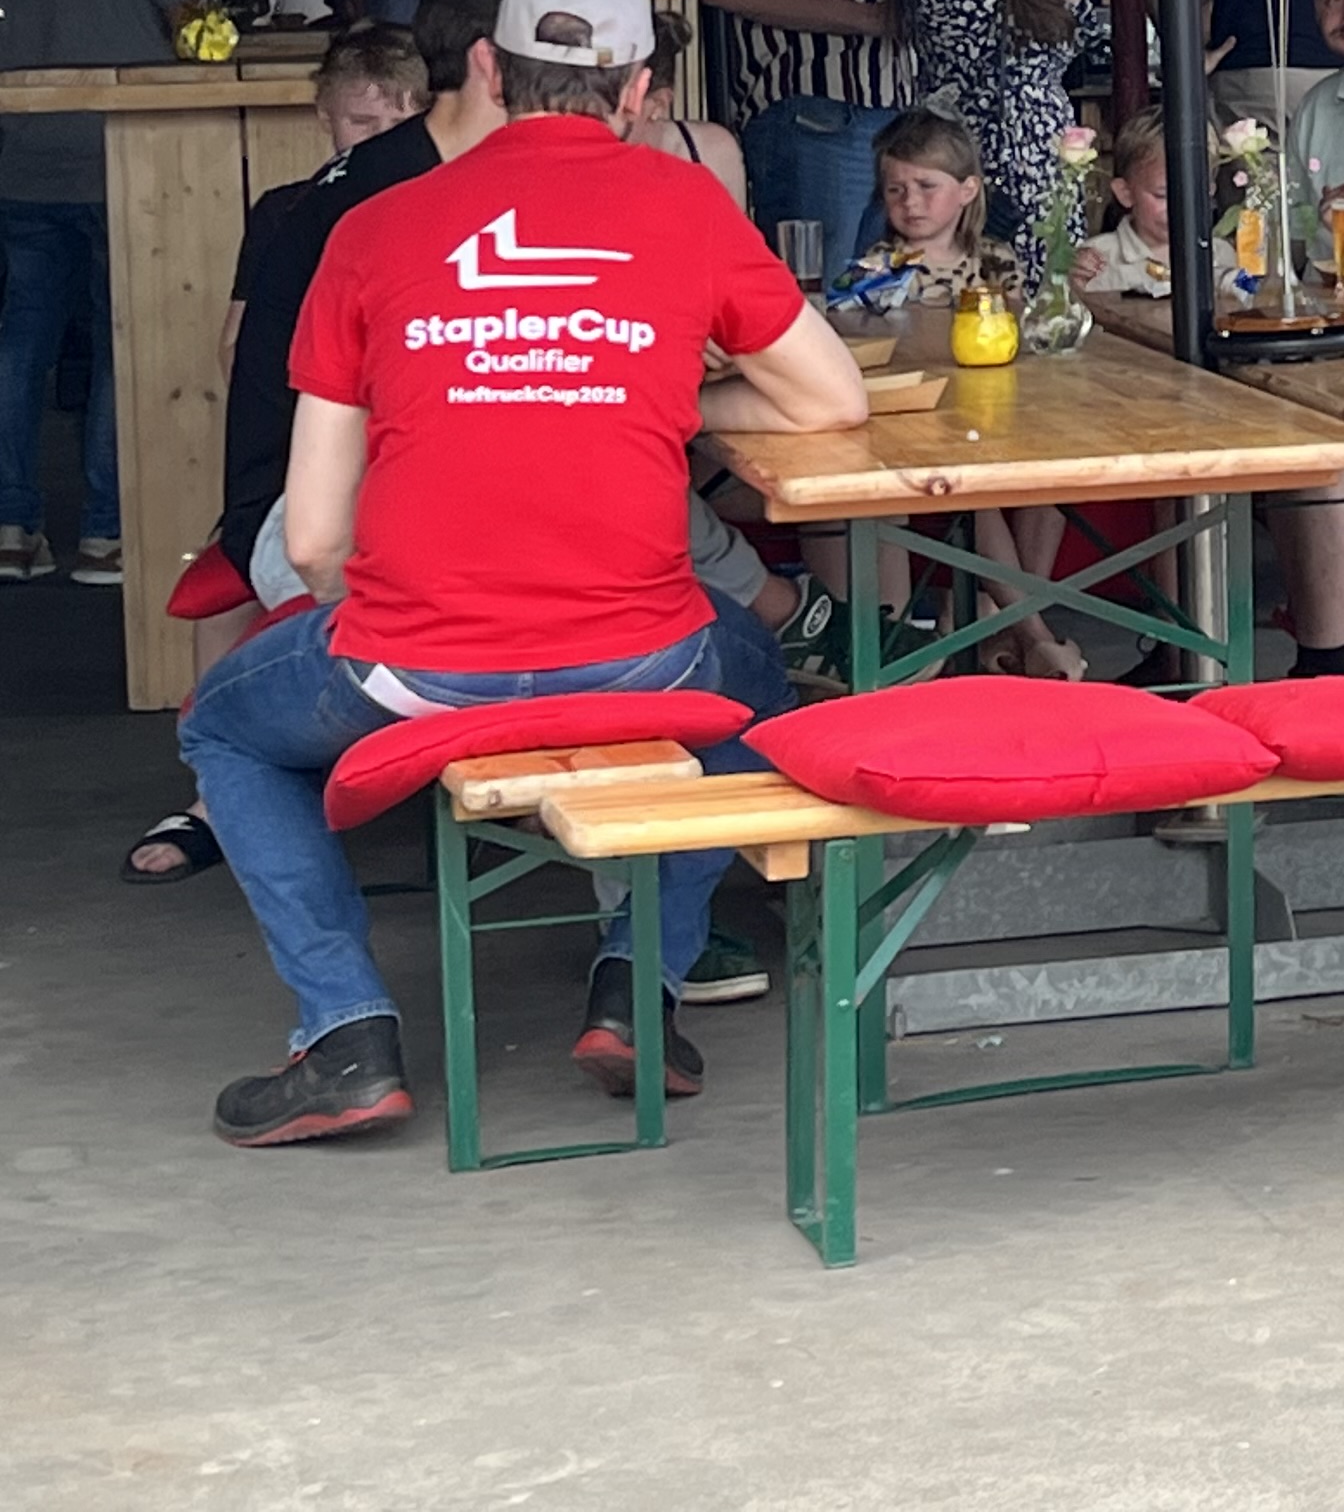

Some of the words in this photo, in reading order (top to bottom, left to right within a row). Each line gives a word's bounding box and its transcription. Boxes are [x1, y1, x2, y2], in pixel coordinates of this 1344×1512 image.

[404, 307, 656, 353] StaplerCup
[464, 348, 594, 374] Qualifier
[447, 385, 627, 407] HeftruckCup2025
